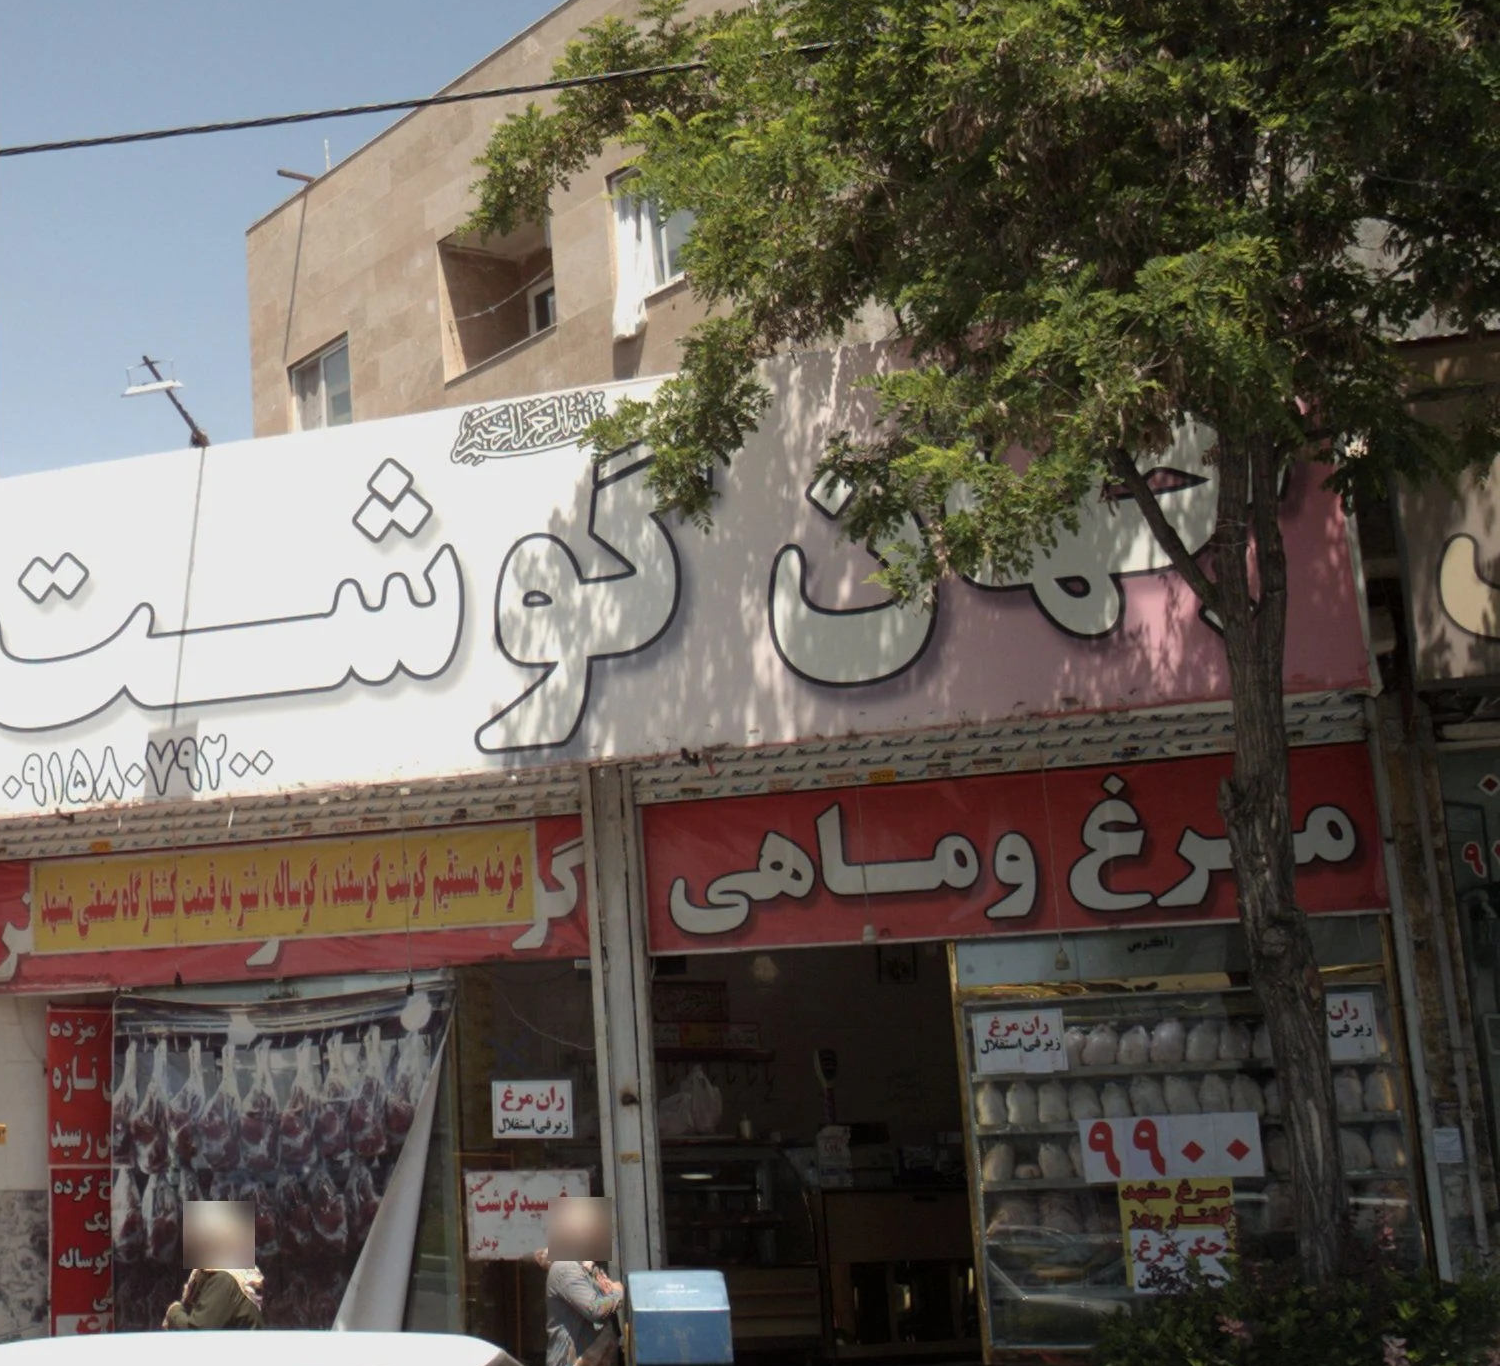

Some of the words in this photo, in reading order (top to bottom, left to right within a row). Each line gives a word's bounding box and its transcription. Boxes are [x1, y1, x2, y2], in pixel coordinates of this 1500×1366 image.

[2, 733, 273, 807] ۰۹۱۵۸۰۷۹۲۰۰
[386, 848, 428, 918] گوشت
[433, 848, 480, 916] مستقیم
[49, 1017, 98, 1046] مژده
[988, 1016, 1019, 1037] مرغ
[1022, 1016, 1049, 1035] ران
[52, 1055, 98, 1102] تازه
[500, 1085, 534, 1112] مرغ
[536, 1087, 565, 1112] ران
[1087, 1119, 1250, 1177] ۹۹۰۰
[54, 1175, 94, 1202] کرده
[1175, 1179, 1231, 1204] مرغ
